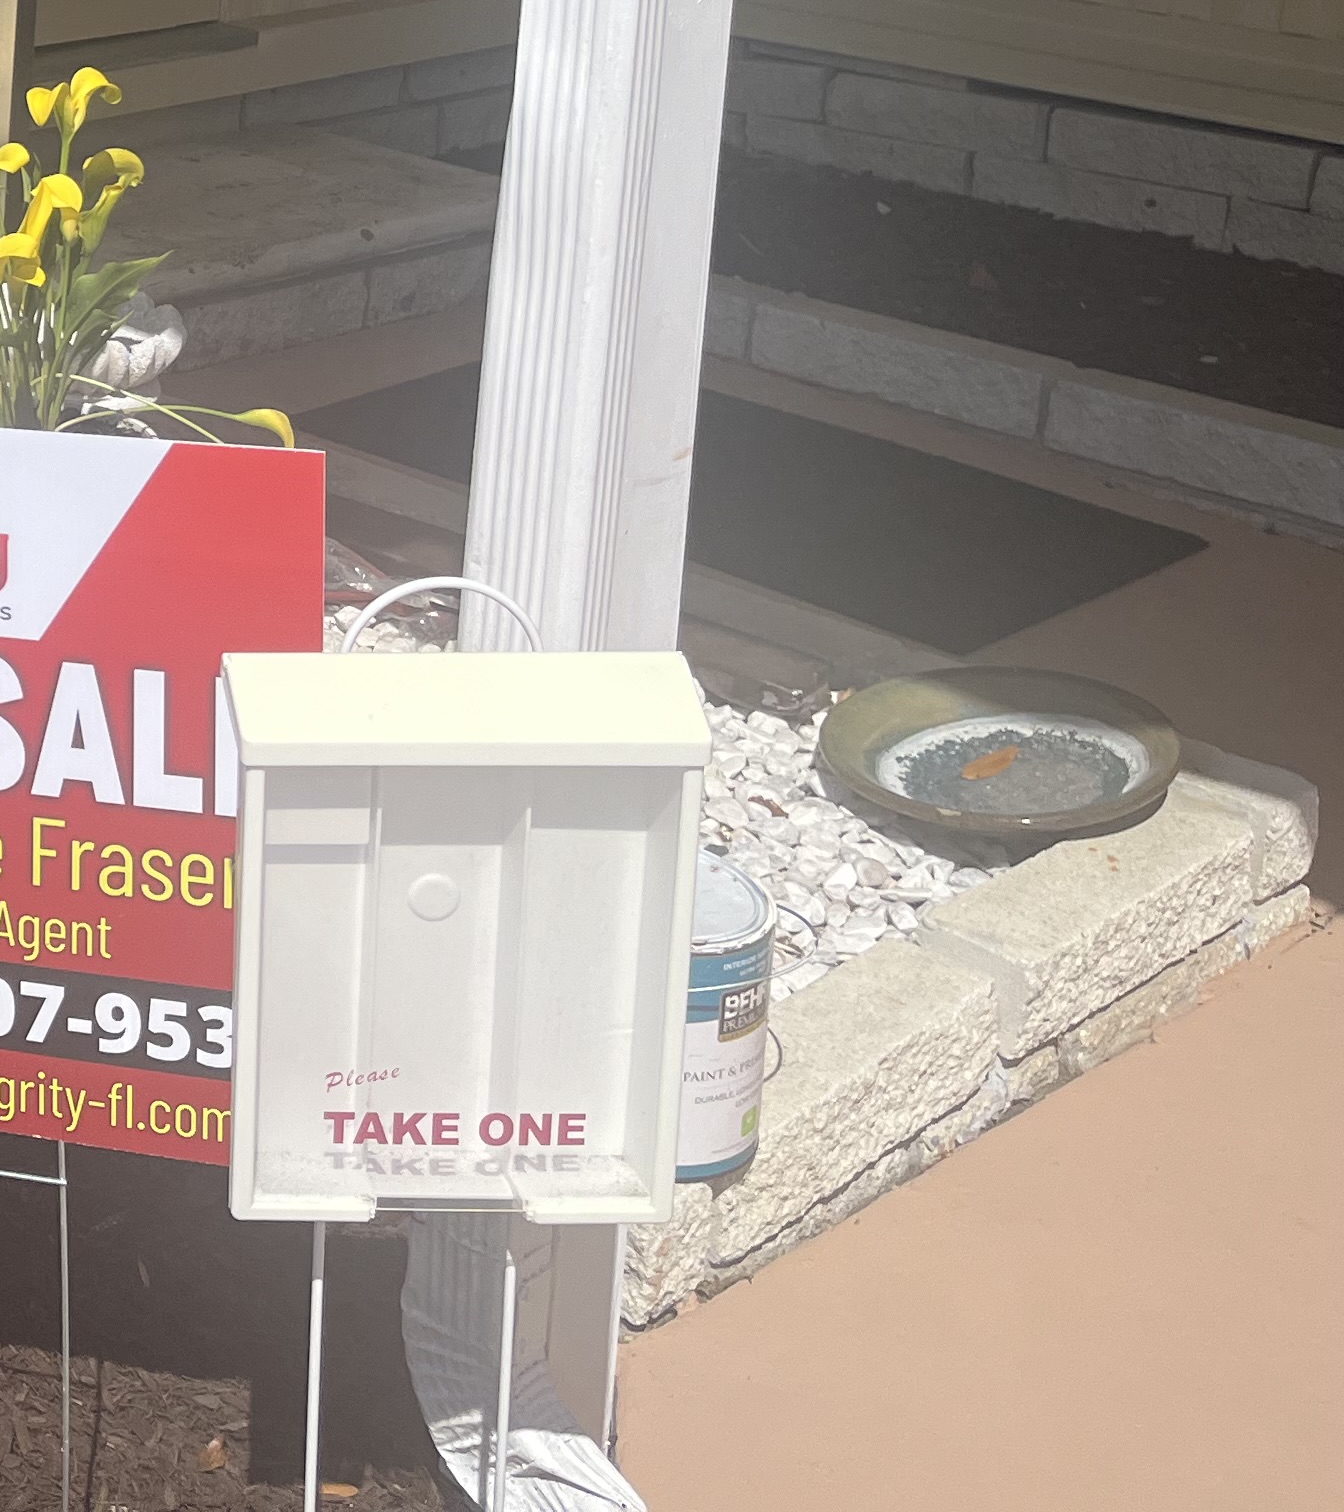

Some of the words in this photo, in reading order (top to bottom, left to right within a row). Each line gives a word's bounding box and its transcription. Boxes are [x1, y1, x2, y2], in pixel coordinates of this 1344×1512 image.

[724, 983, 766, 1020] BEH
[324, 1067, 401, 1093] Please
[683, 1068, 726, 1083] PAINT
[323, 1111, 461, 1146] TAKE
[478, 1112, 587, 1147] ONE
